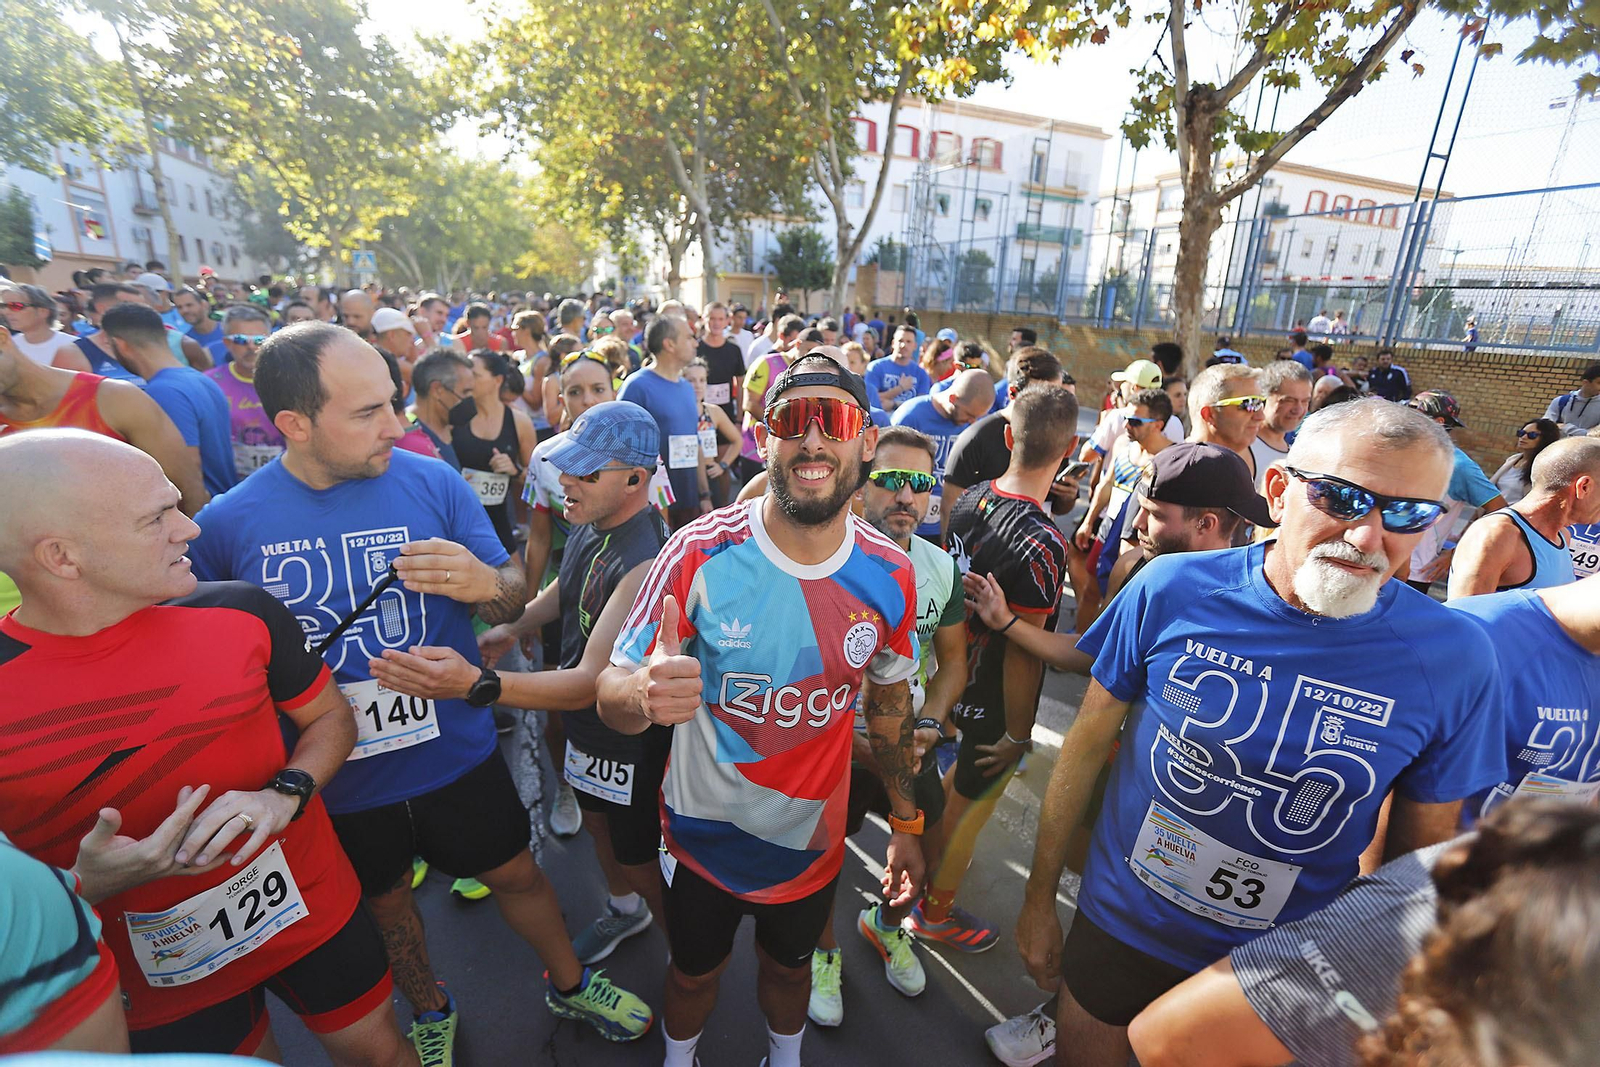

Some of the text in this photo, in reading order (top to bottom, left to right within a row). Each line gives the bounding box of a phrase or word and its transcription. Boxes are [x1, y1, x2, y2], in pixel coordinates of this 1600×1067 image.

[481, 482, 505, 496] 369
[930, 504, 940, 516] 9
[261, 537, 327, 557] VUELTA A
[349, 532, 404, 548] 12/10/22
[718, 638, 752, 649] adidas
[847, 625, 866, 643] AJAX
[1185, 638, 1273, 681] VUELTA A
[365, 695, 429, 732] 140
[1303, 685, 1384, 717] 12/10/22
[1537, 706, 1580, 721] VUELTA
[1159, 722, 1200, 759] HUELVA
[1342, 738, 1377, 753] HUELVA
[1150, 654, 1396, 855] 35
[585, 754, 629, 786] 205
[1167, 747, 1262, 797] #35añoscorriendo
[1154, 825, 1197, 853] 35 VUELTA
[1156, 837, 1197, 862] A HUELVA
[1235, 857, 1260, 870] FCO
[226, 865, 259, 896] JORGE
[1205, 866, 1266, 909] 53
[209, 870, 288, 941] 129
[141, 931, 156, 942] 35
[157, 915, 197, 938] VUELTA
[152, 940, 160, 949] A
[160, 922, 202, 946] HUELVA
